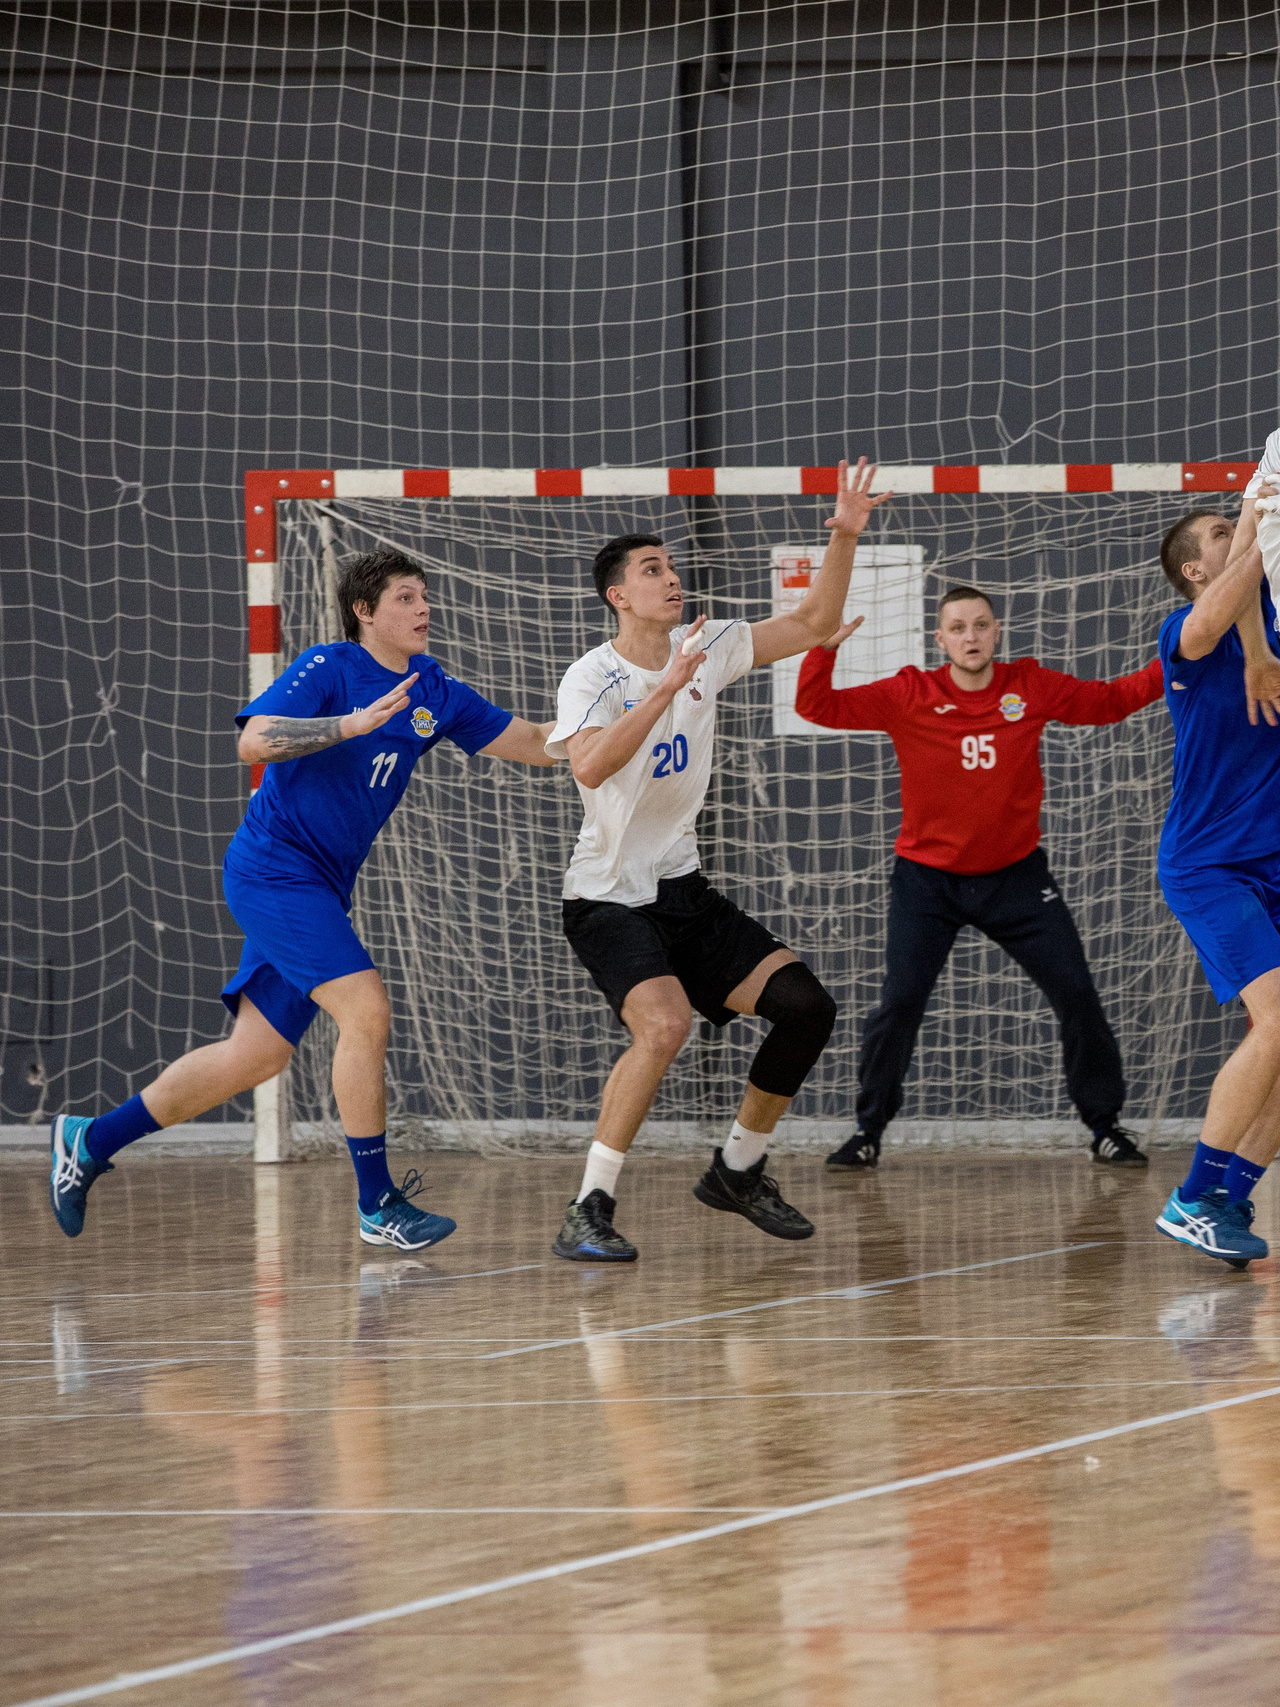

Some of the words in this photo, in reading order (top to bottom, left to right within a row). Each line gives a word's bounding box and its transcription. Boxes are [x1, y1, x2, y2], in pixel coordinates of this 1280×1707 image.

[369, 752, 398, 788] 11
[652, 733, 689, 778] 20
[961, 733, 997, 771] 95
